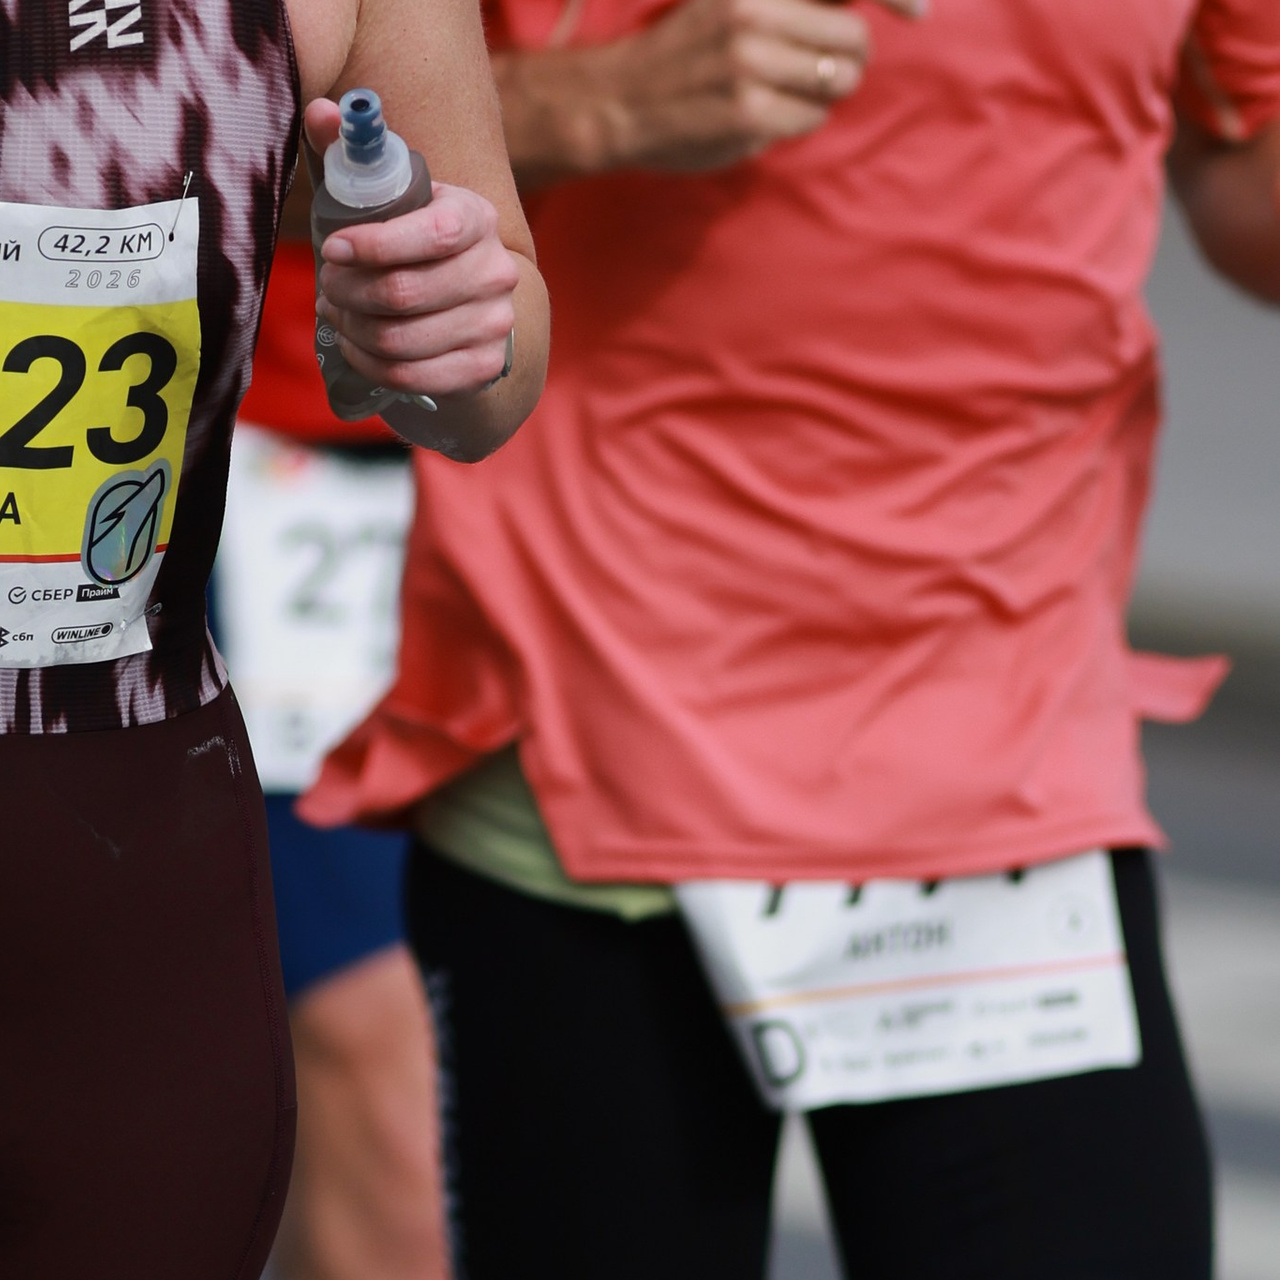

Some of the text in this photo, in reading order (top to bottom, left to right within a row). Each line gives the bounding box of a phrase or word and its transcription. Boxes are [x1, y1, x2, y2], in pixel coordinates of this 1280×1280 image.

[54, 231, 152, 257] 42,2 КМ
[65, 269, 141, 289] 2026
[31, 588, 74, 601] СБЕР
[12, 632, 34, 641] сбп
[56, 627, 102, 640] WINLINE
